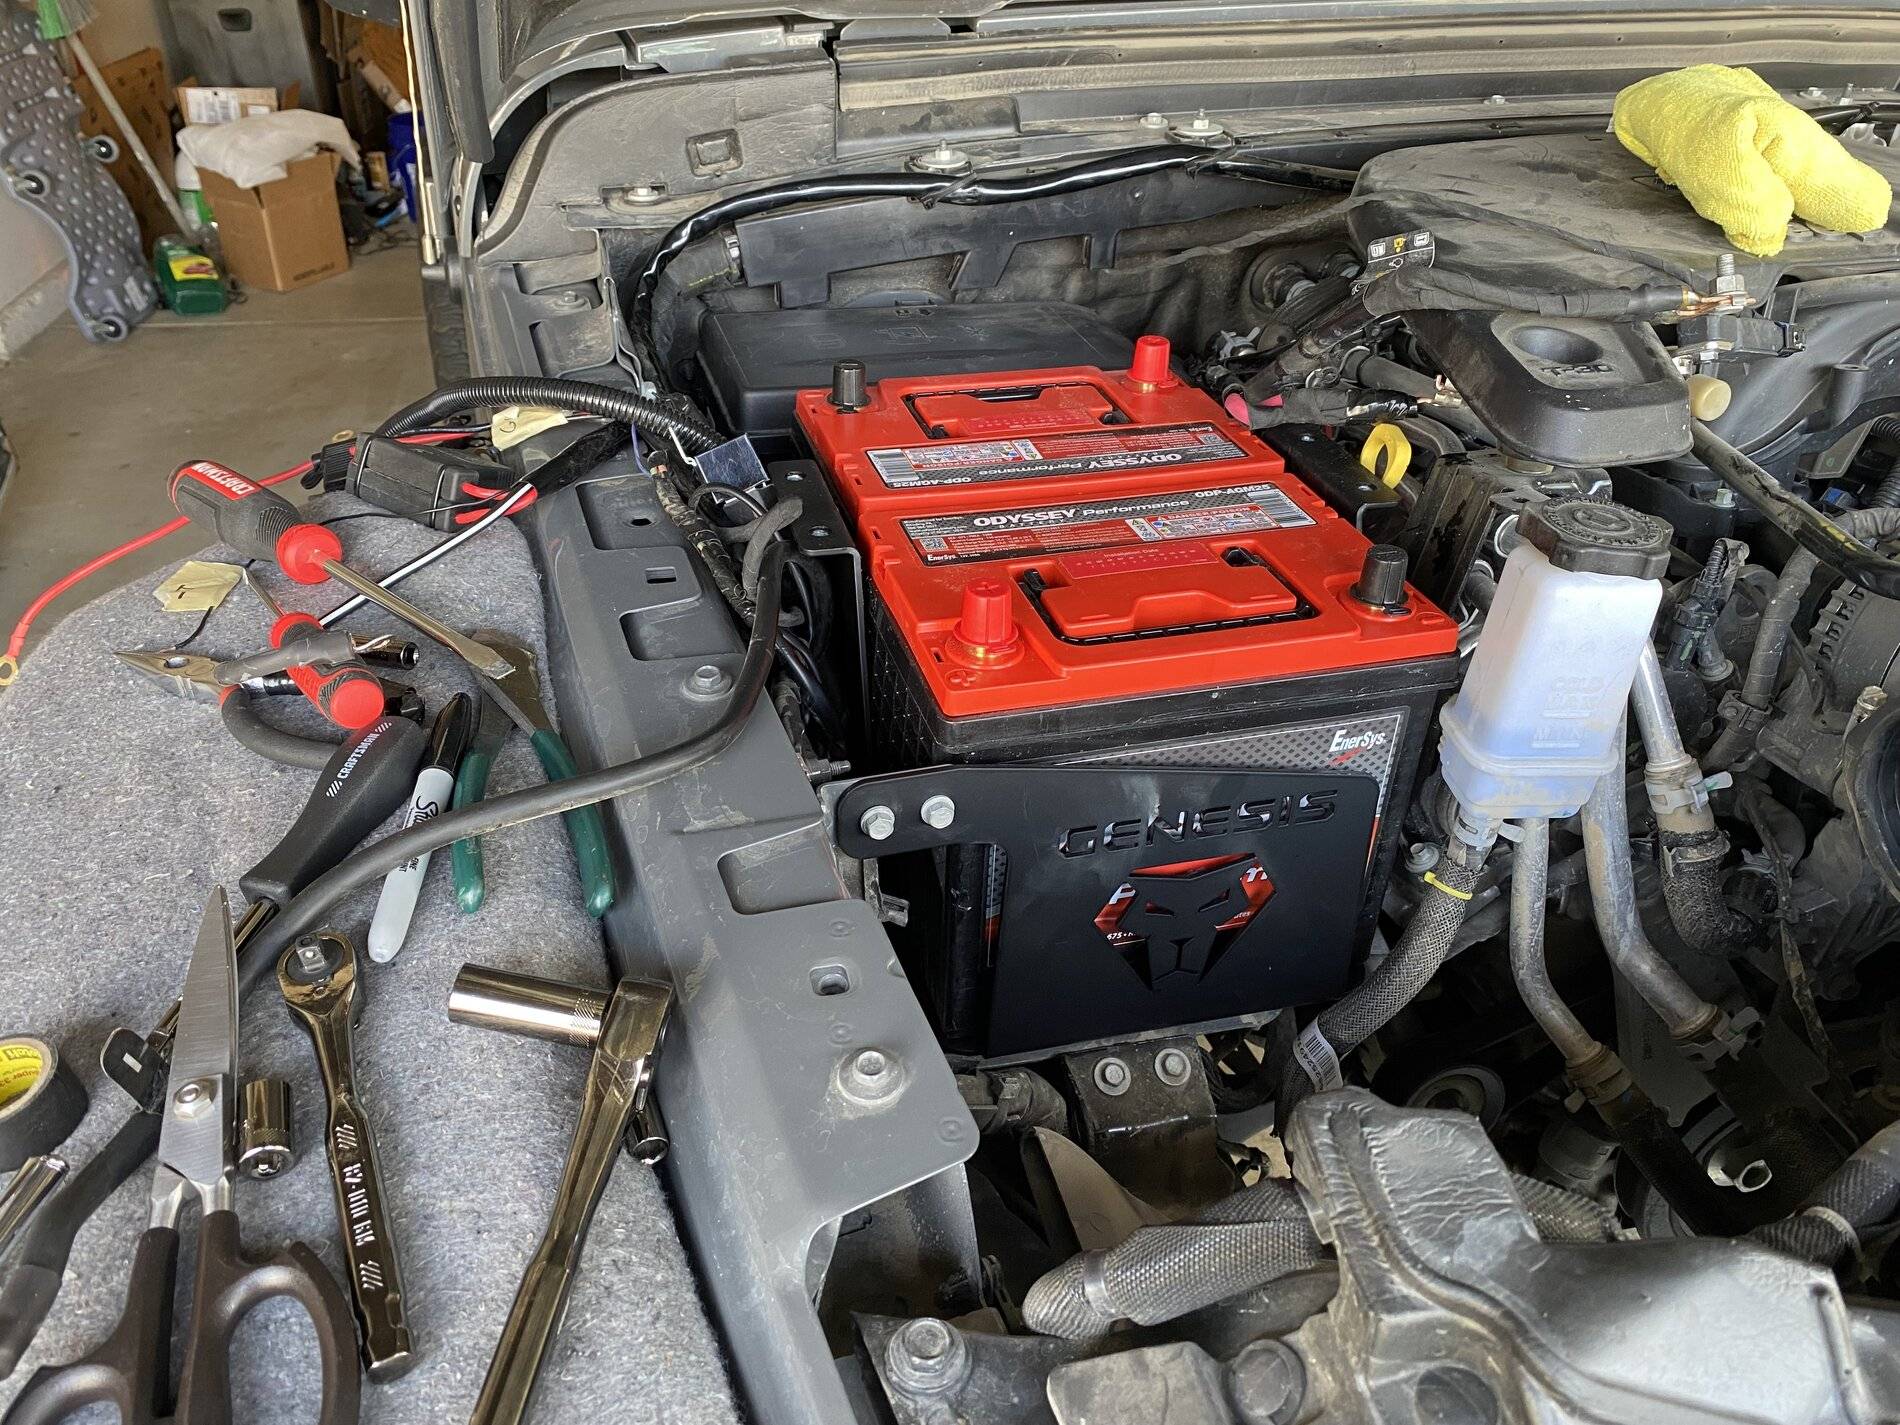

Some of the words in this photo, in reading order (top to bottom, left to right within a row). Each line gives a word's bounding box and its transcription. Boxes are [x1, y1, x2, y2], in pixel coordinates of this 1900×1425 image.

[978, 461, 1082, 476] Performance
[1089, 452, 1183, 469] ODYSSEY
[191, 462, 256, 495] CRAFTSMAN
[892, 476, 972, 489] ODP-AGM25
[1194, 483, 1272, 499] ODP-AGM25
[973, 508, 1077, 527] ODYSSEY
[1083, 499, 1190, 517] Performance
[336, 733, 380, 779] CRAFTSMAN
[1057, 788, 1339, 860] GENESIS
